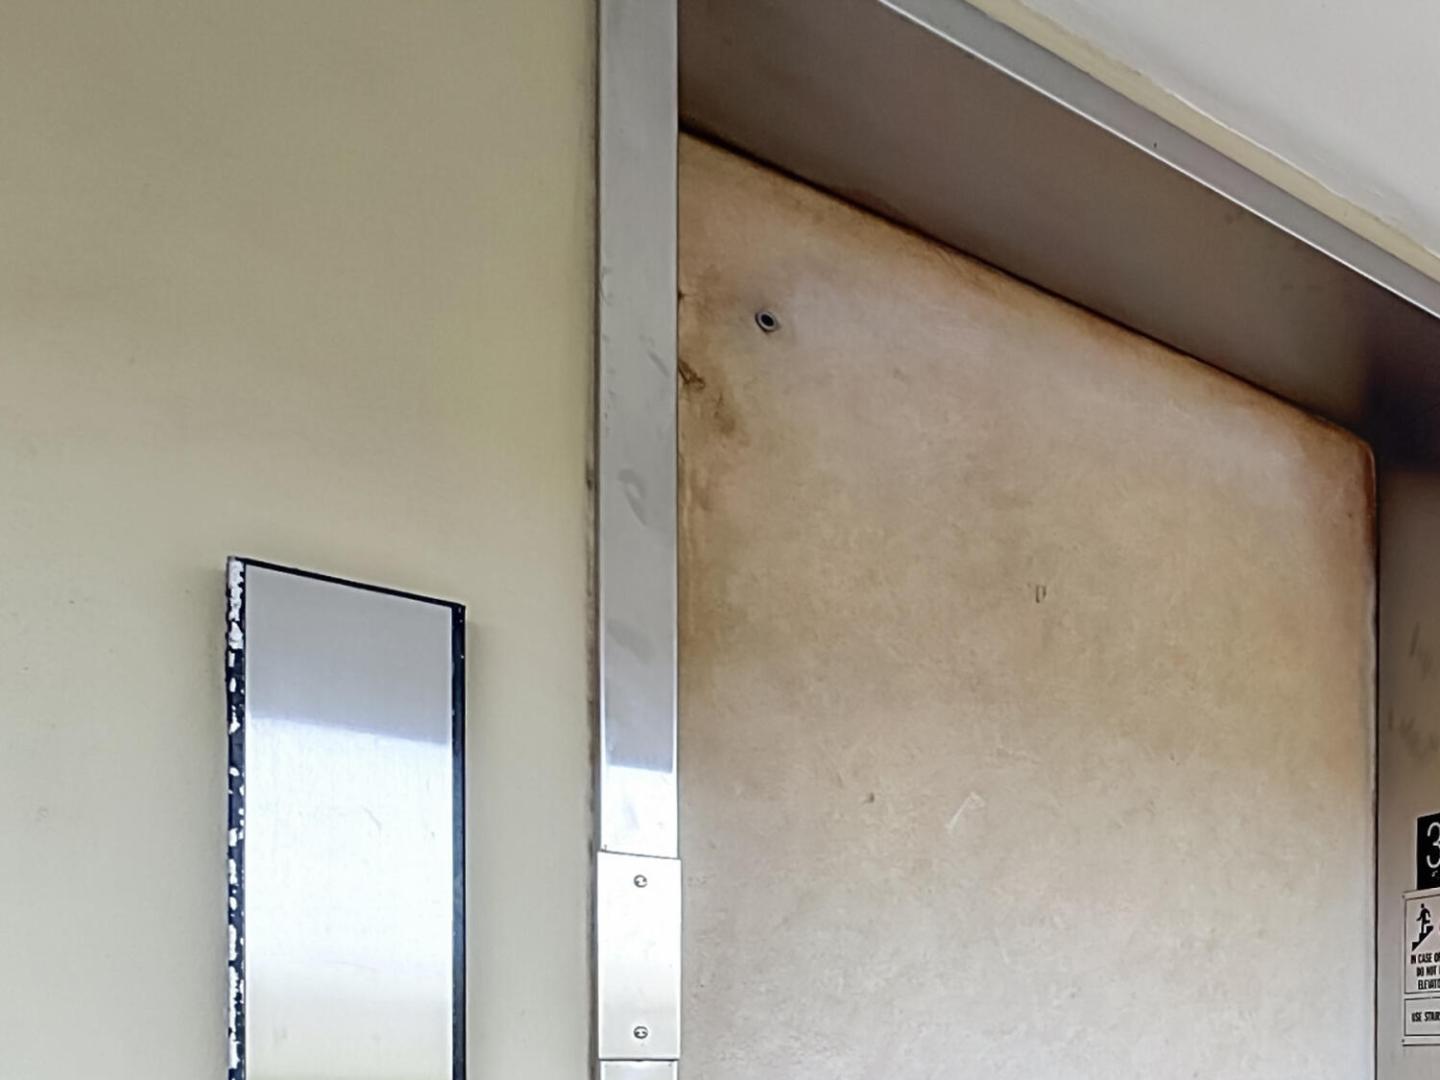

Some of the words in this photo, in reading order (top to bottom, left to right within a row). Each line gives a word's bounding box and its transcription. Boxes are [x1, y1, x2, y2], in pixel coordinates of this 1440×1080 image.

[1410, 954, 1416, 964] IN
[1418, 953, 1432, 963] CASE
[1434, 951, 1440, 962] OF
[1416, 966, 1424, 977] DO
[1426, 965, 1437, 976] NOT
[1411, 1012, 1422, 1022] USE
